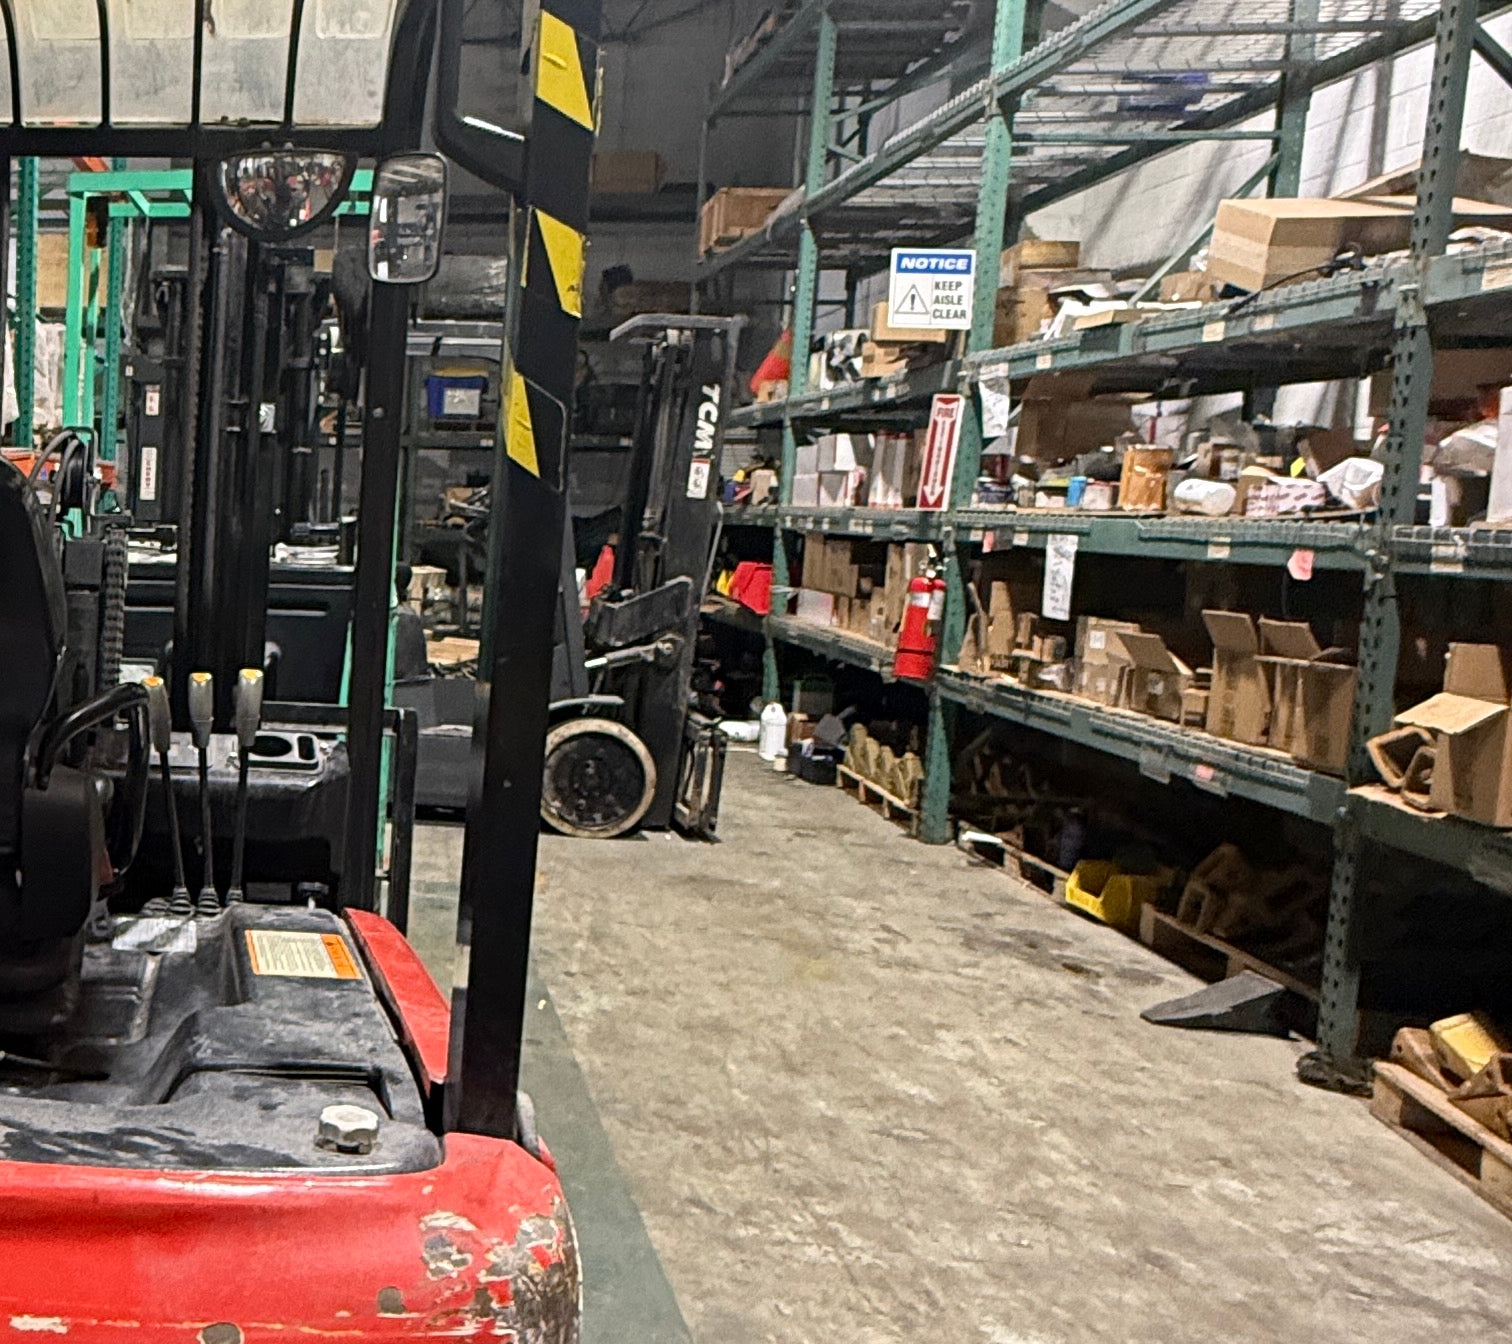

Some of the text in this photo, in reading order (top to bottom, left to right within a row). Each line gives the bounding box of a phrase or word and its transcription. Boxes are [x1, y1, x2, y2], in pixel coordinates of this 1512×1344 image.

[900, 257, 969, 270] NOTICE
[934, 281, 962, 291] KEEP
[933, 295, 964, 306] AISLE
[932, 308, 967, 320] CLEAR
[693, 383, 720, 449] TCM
